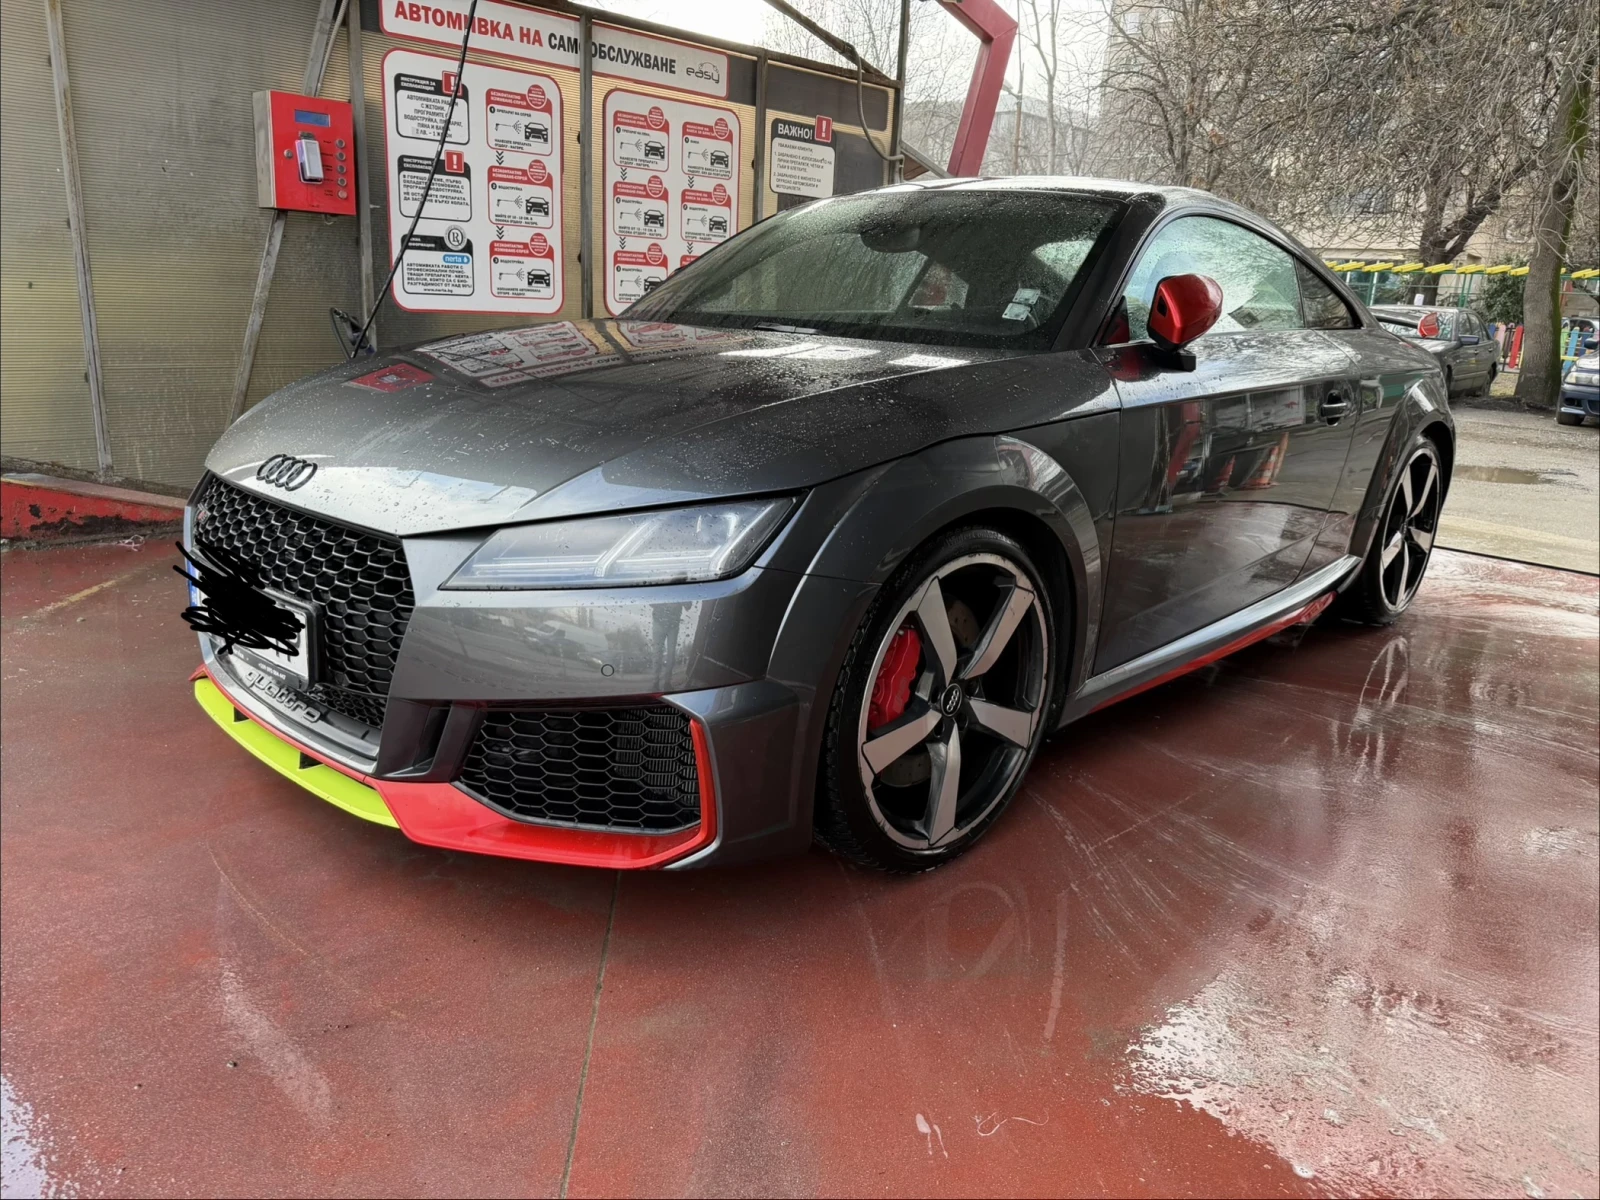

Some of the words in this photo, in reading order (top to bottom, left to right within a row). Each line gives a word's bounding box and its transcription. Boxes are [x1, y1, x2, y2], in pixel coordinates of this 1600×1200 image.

[520, 26, 543, 47] НА
[686, 66, 720, 84] easy
[778, 124, 812, 139] ВАЖНО!
[246, 671, 320, 723] quattro
